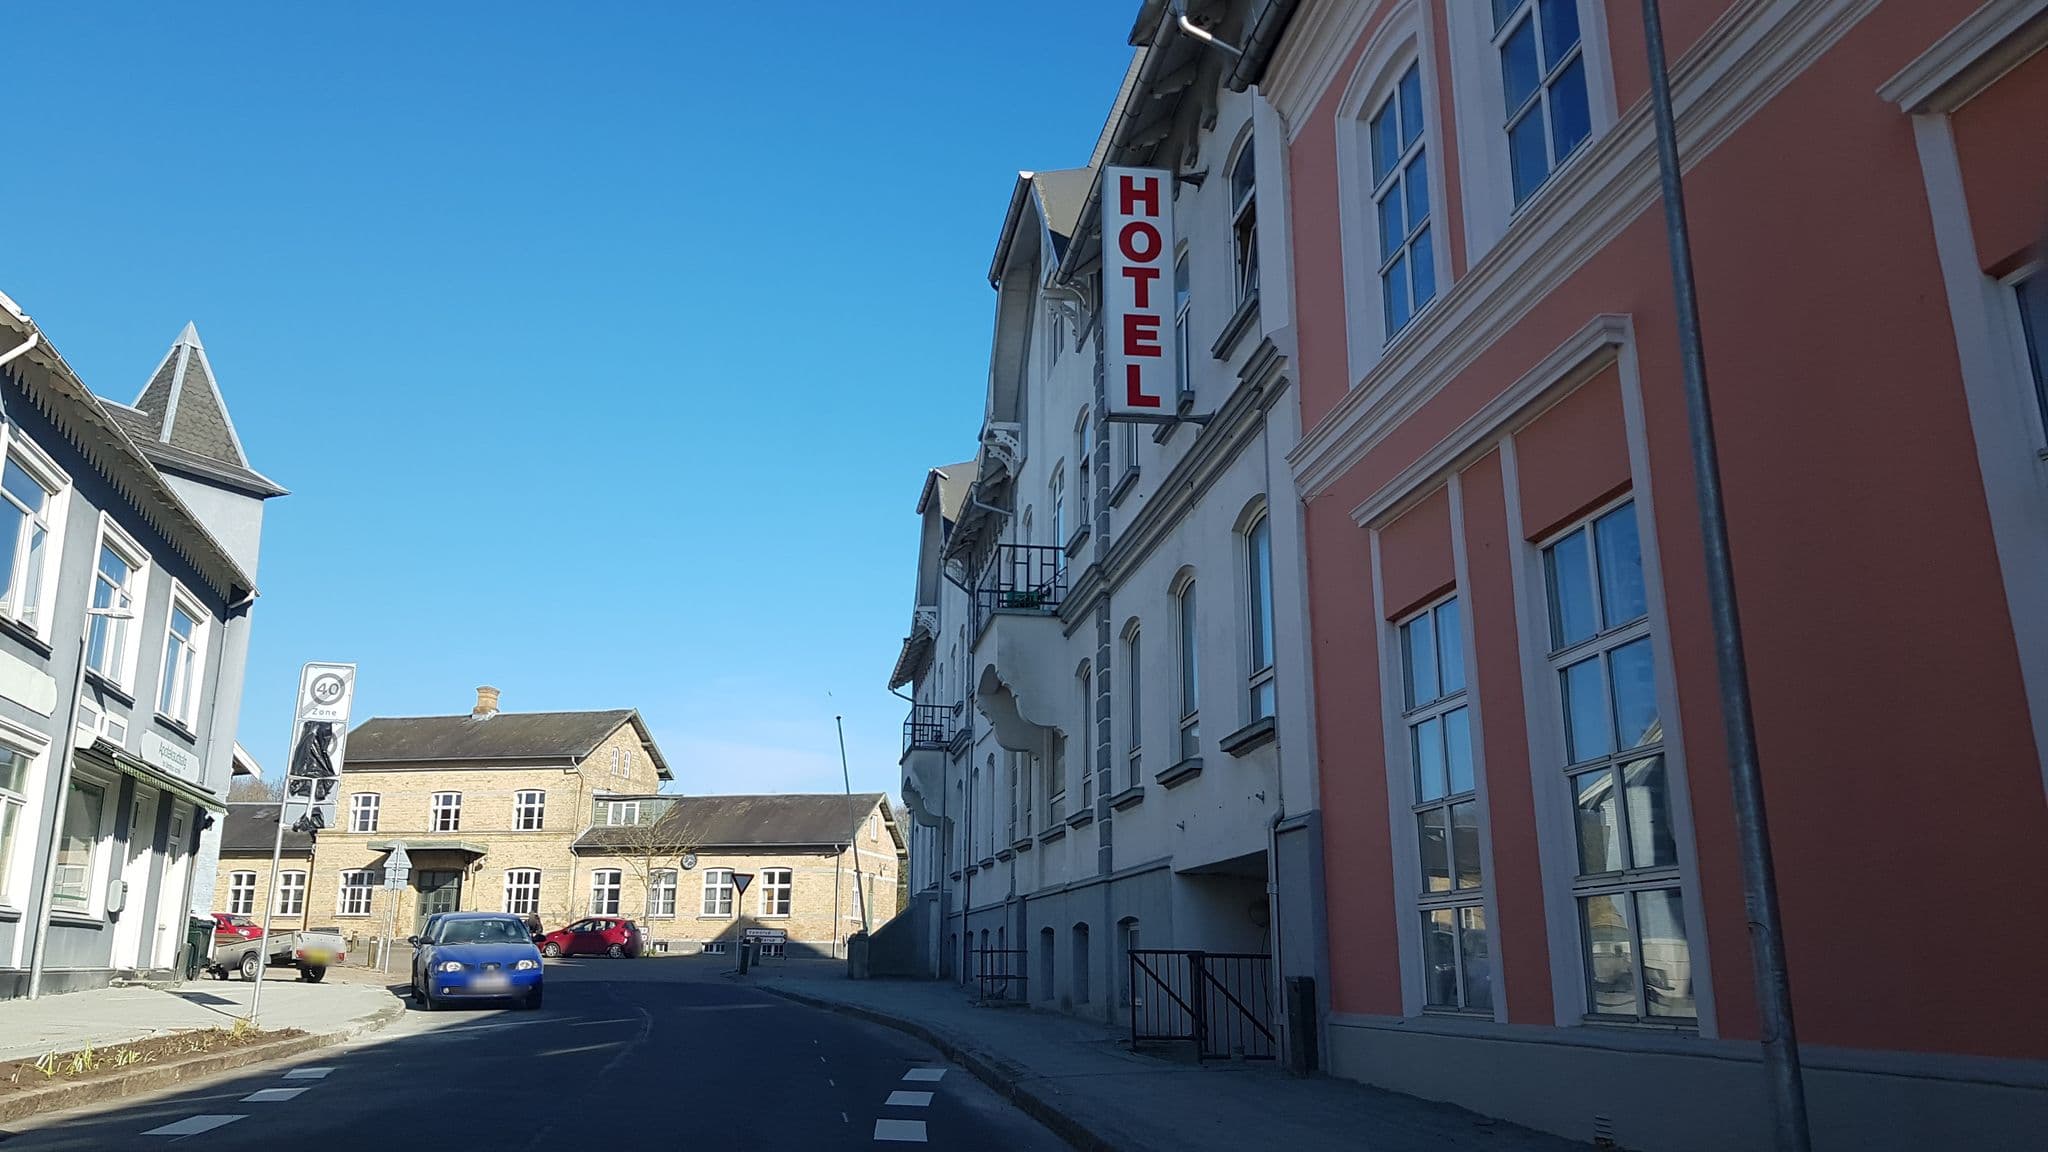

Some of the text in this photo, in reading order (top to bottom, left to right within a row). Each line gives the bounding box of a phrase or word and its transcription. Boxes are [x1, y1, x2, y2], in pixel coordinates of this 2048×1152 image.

[1118, 175, 1162, 408] HOTEL
[316, 683, 339, 696] 40
[312, 707, 337, 716] Zone
